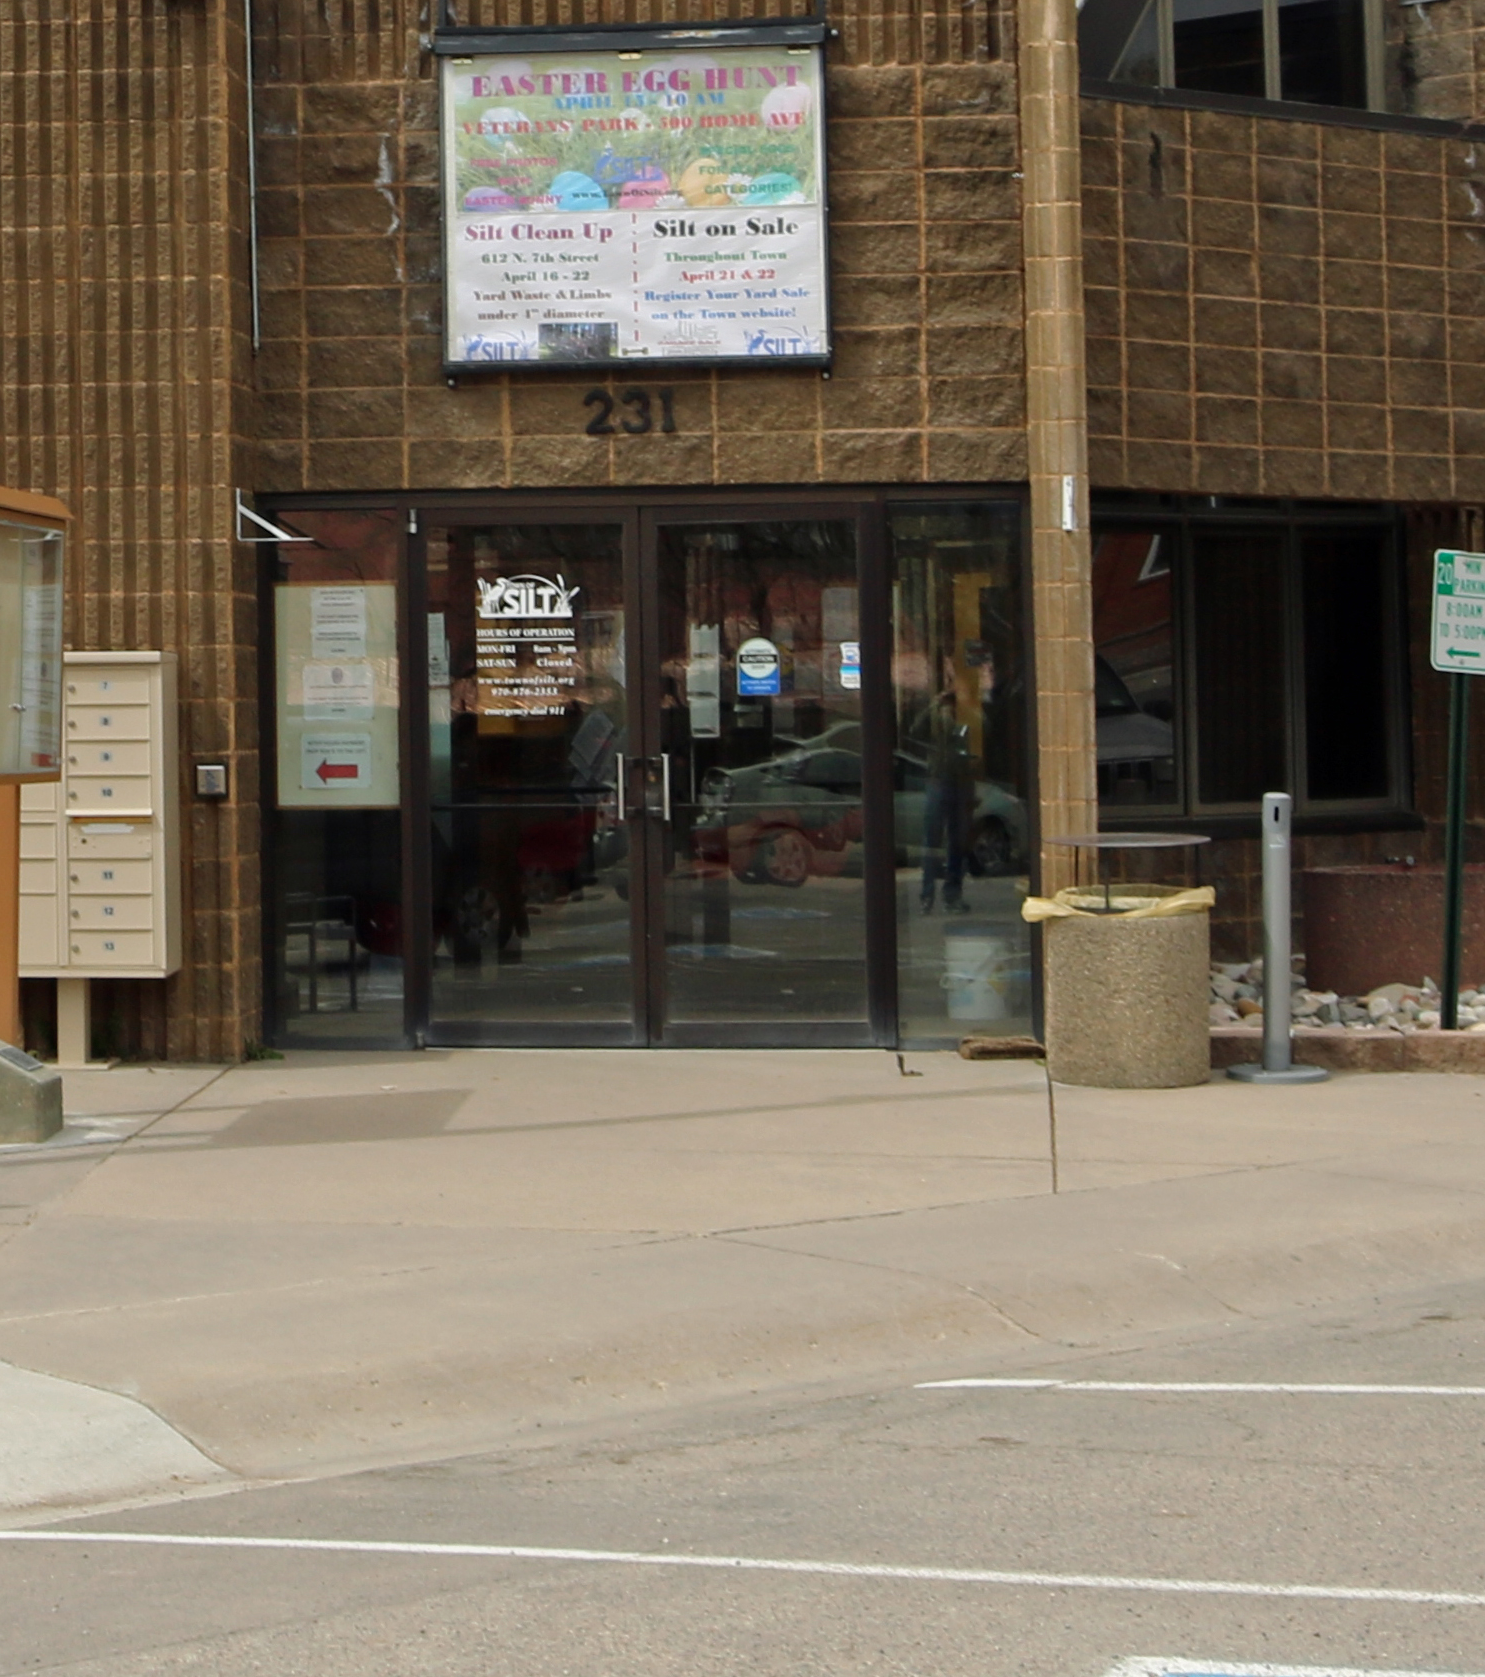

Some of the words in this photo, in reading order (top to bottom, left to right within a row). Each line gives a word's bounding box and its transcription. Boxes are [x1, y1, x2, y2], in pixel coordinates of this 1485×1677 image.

[472, 73, 608, 97] EASTER
[622, 69, 691, 92] EGG
[704, 65, 802, 89] HUNT
[554, 95, 614, 110] APRIL
[462, 120, 575, 135] VETERANS
[582, 117, 639, 132] PARK
[700, 113, 760, 128] HOME
[465, 195, 515, 205] EASTER
[465, 224, 503, 241] Silt
[510, 223, 574, 240] Clean
[582, 222, 614, 243] Up
[653, 219, 696, 238] Silt
[705, 224, 737, 237] on
[745, 217, 799, 236] Sale
[481, 253, 508, 264] 612
[532, 253, 555, 263] 7th
[558, 252, 600, 263] Street
[664, 251, 746, 264] Throughout
[750, 250, 787, 260] Town
[501, 271, 537, 285] April
[572, 270, 590, 281] 22
[680, 270, 715, 284] April
[719, 270, 736, 281] 21
[740, 269, 754, 280] &
[757, 268, 776, 279] 22
[473, 290, 506, 301] Yard
[510, 290, 551, 301] Waste
[569, 289, 612, 300] Limbs
[644, 290, 701, 303] Register
[705, 289, 740, 300] Your
[744, 288, 777, 299] Yard
[781, 287, 811, 298] Sale
[478, 310, 519, 320] under
[543, 309, 605, 319] diameter
[651, 311, 669, 320] on
[673, 310, 695, 320] the
[699, 309, 736, 319] Town
[481, 341, 520, 360] SILT
[763, 338, 802, 355] SILT
[583, 388, 677, 436] 231
[1438, 563, 1453, 584] 20
[503, 587, 557, 614] SILT
[1446, 602, 1483, 618] 8:00AM
[476, 628, 508, 637] HOURS
[509, 628, 522, 637] OF
[523, 627, 575, 637] OPERATION
[476, 644, 516, 654] MON-FRI
[476, 658, 516, 668] SAT-SUN
[536, 658, 573, 667] Closed
[530, 706, 548, 716] dial
[549, 706, 566, 716] 911
